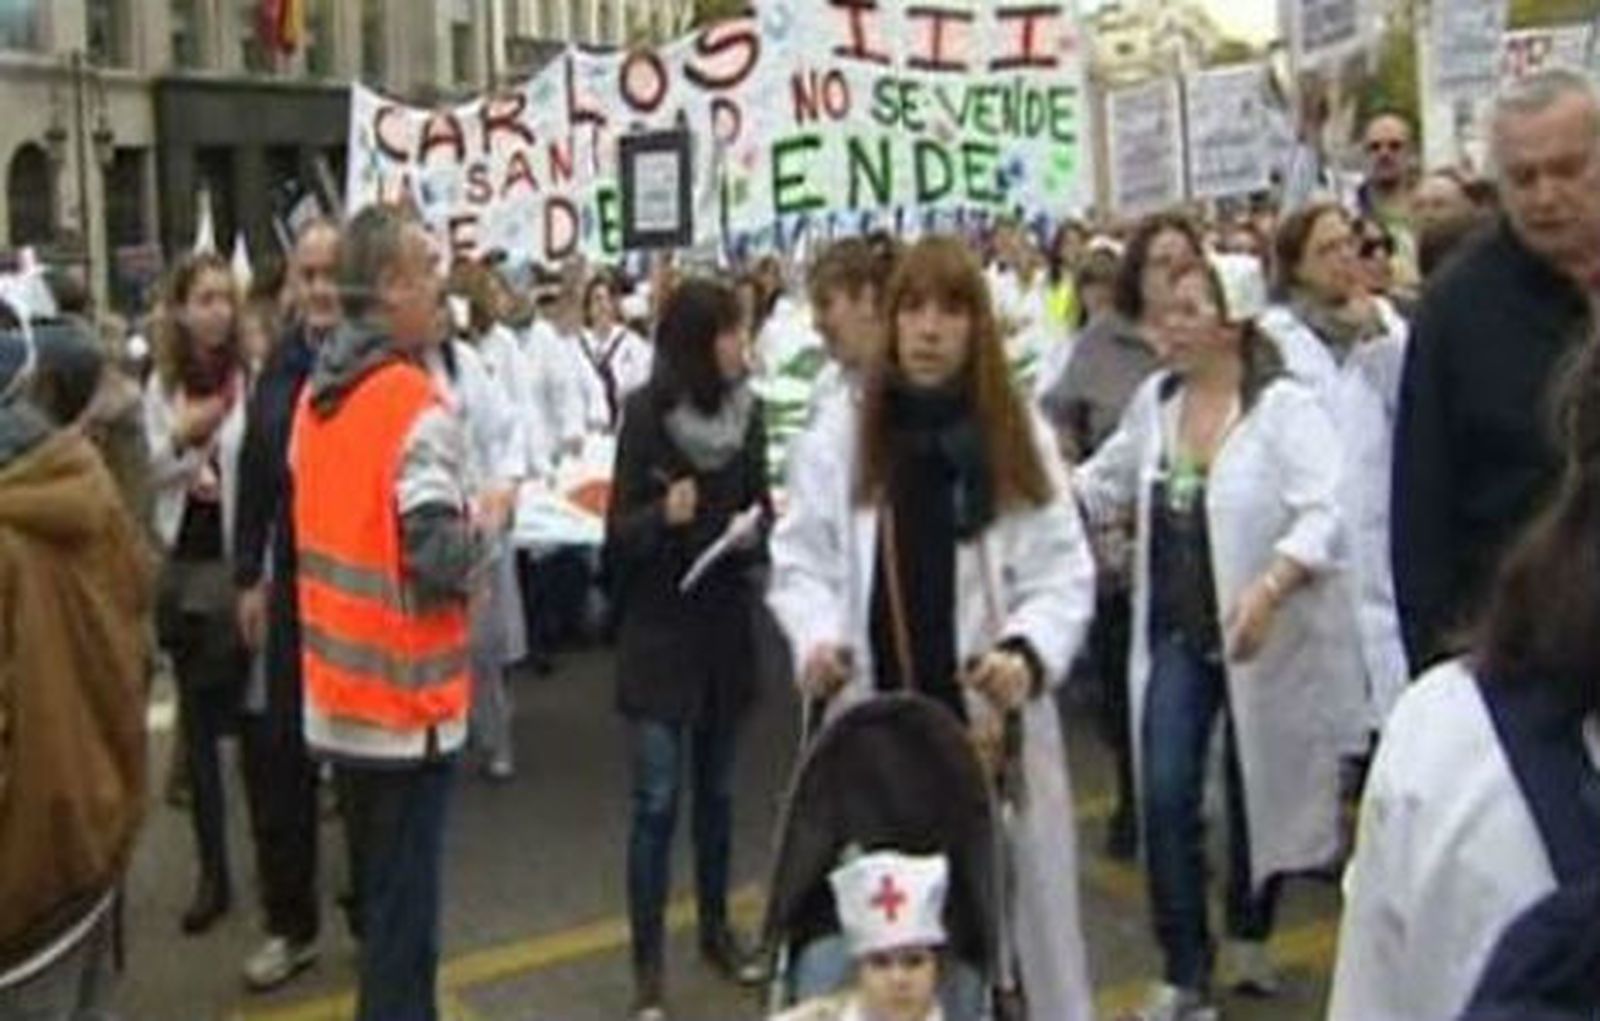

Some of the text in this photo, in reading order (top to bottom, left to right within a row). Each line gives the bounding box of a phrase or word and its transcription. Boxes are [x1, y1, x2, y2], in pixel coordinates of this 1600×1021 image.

[374, 0, 1062, 163] CARLOS III
[791, 68, 850, 127] NO
[870, 76, 927, 131] SE
[935, 77, 1078, 143] VENDE
